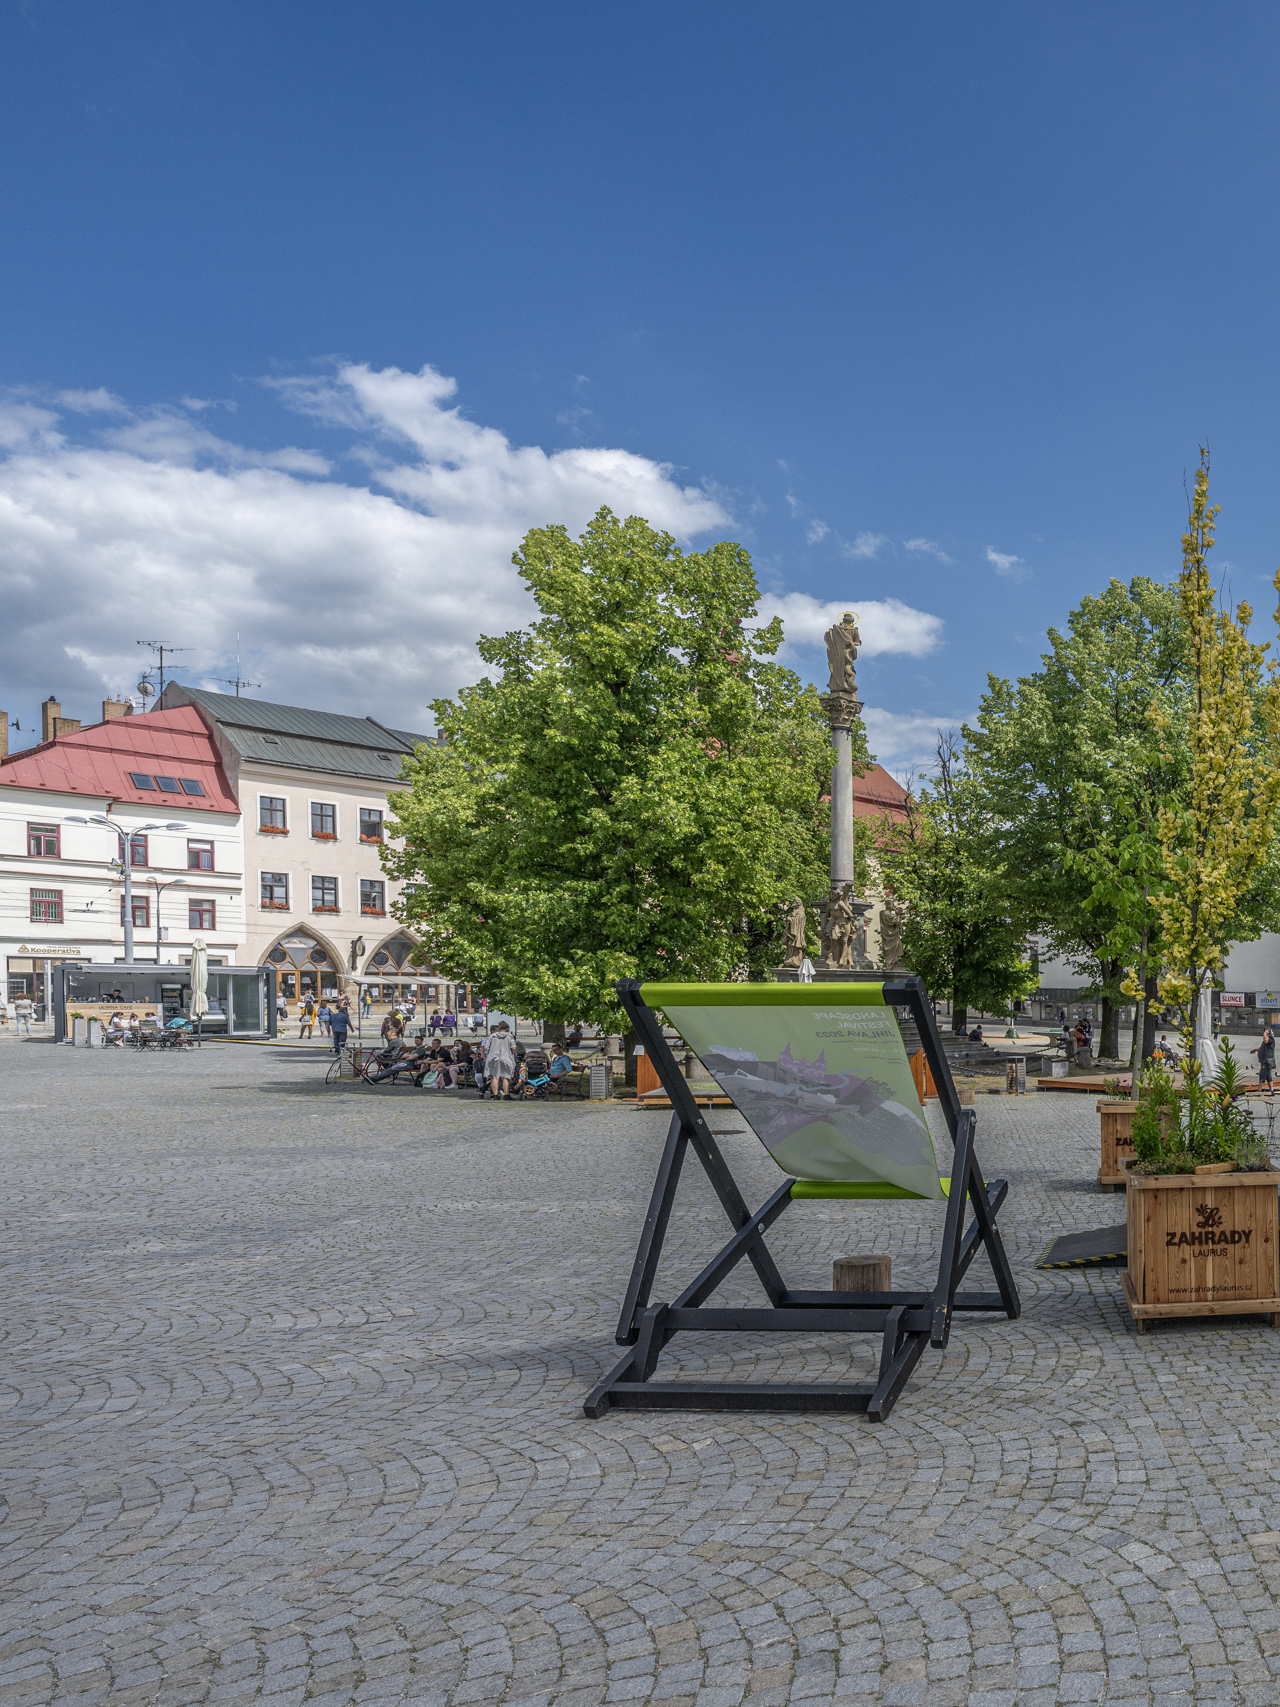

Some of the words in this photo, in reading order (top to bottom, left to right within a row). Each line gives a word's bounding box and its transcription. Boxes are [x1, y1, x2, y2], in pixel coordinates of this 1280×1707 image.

[1166, 1229, 1253, 1247] ZAHRADY
[1192, 1247, 1228, 1258] LAURUS
[1168, 1284, 1253, 1294] www.zahradylaurus.cz
